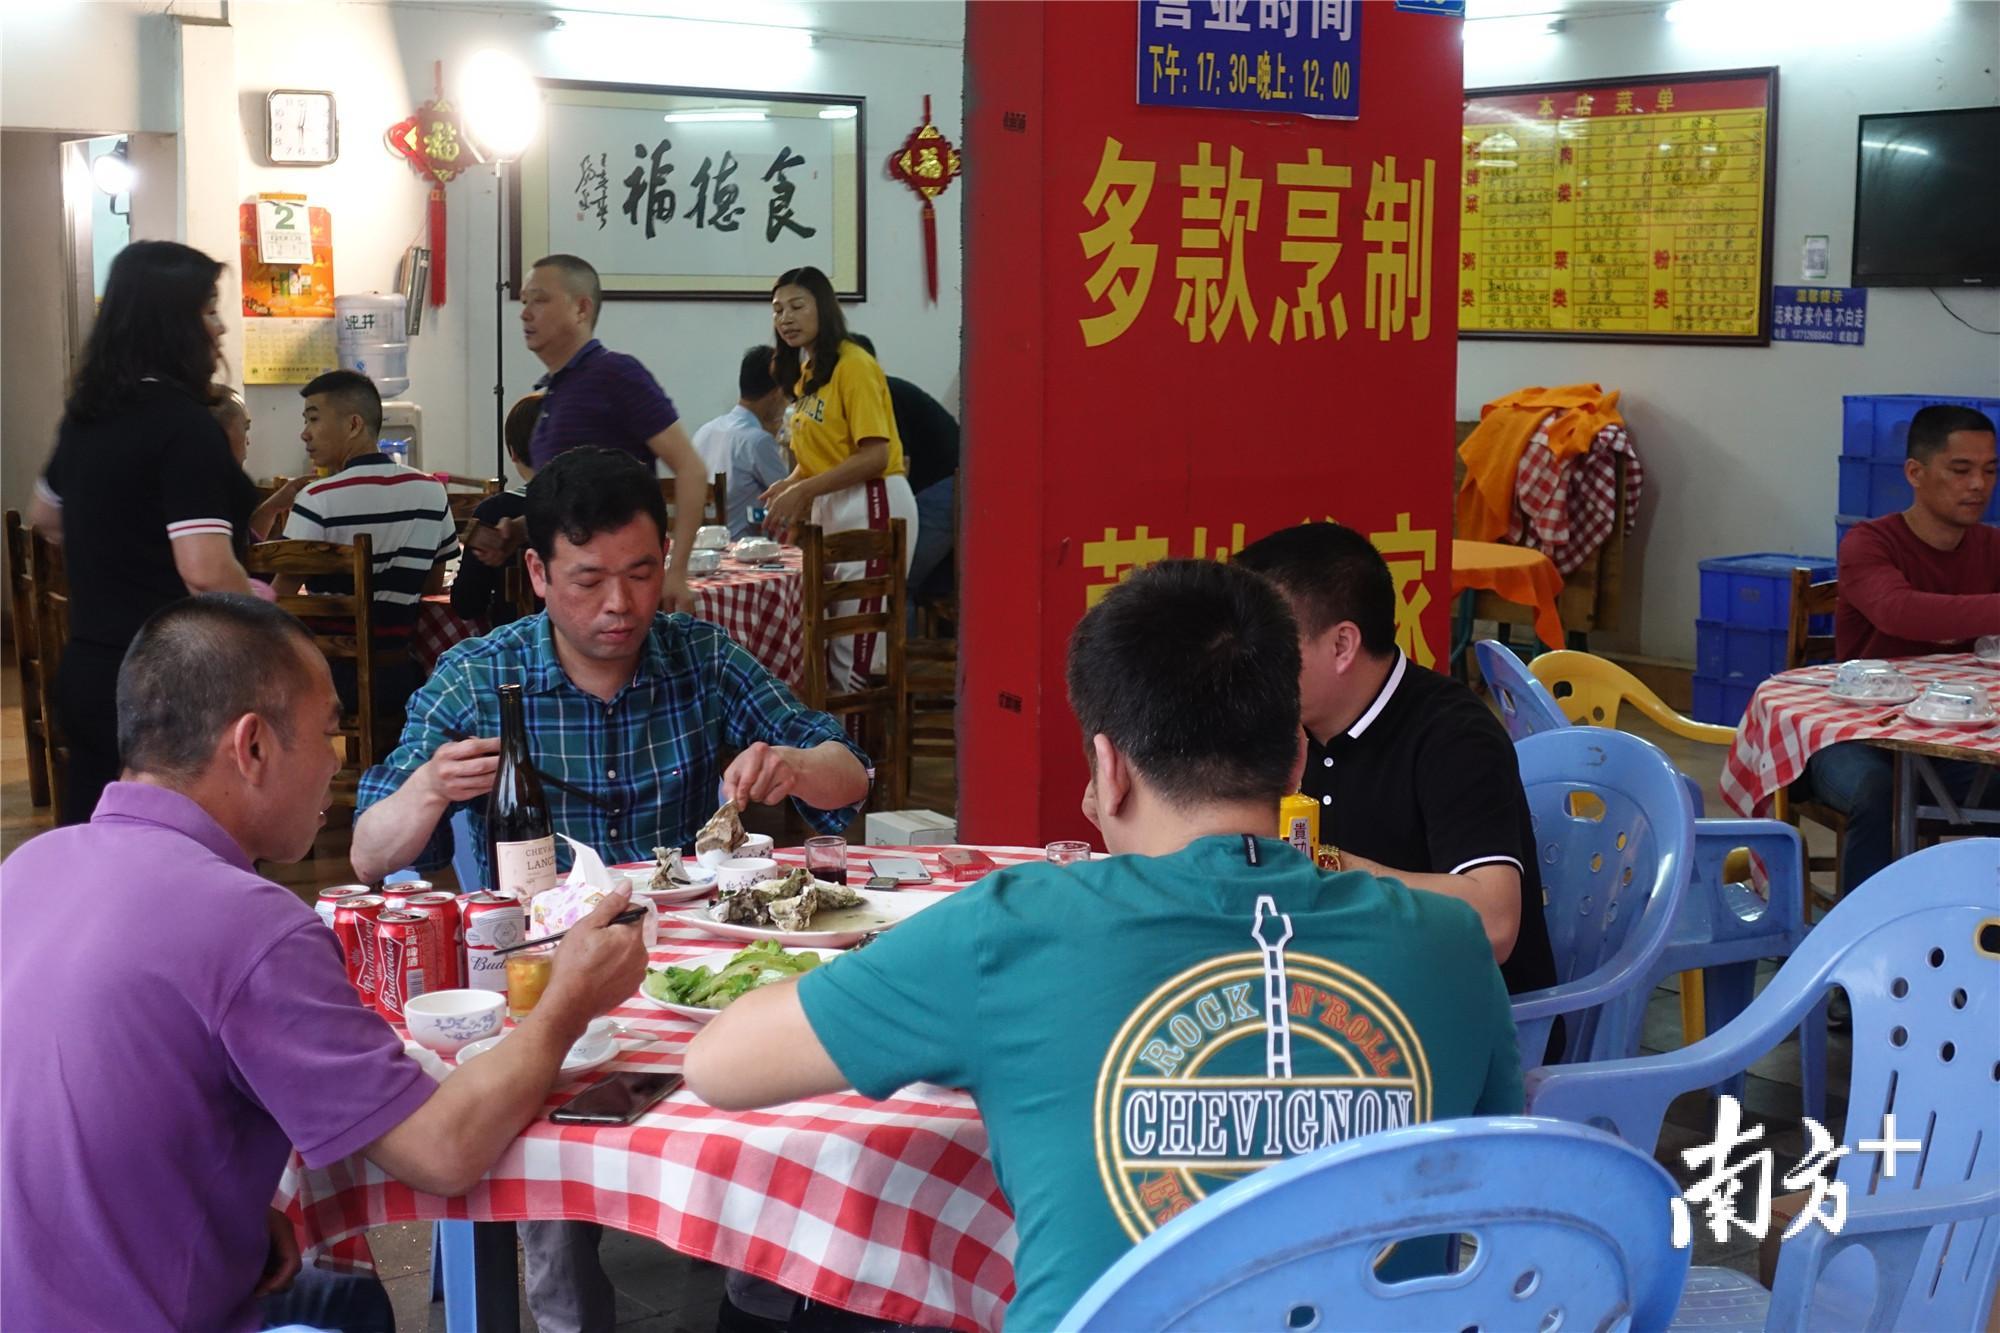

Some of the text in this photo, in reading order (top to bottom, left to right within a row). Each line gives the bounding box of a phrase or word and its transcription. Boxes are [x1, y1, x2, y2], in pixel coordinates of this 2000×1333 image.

[1538, 87, 1675, 118] 本店菜单
[274, 205, 296, 230] 2
[1078, 135, 1436, 348] 多款烹制
[383, 936, 398, 1012] Budweiser
[1139, 981, 1260, 1079] ROCK
[1124, 1088, 1413, 1156] CHEVIGNON
